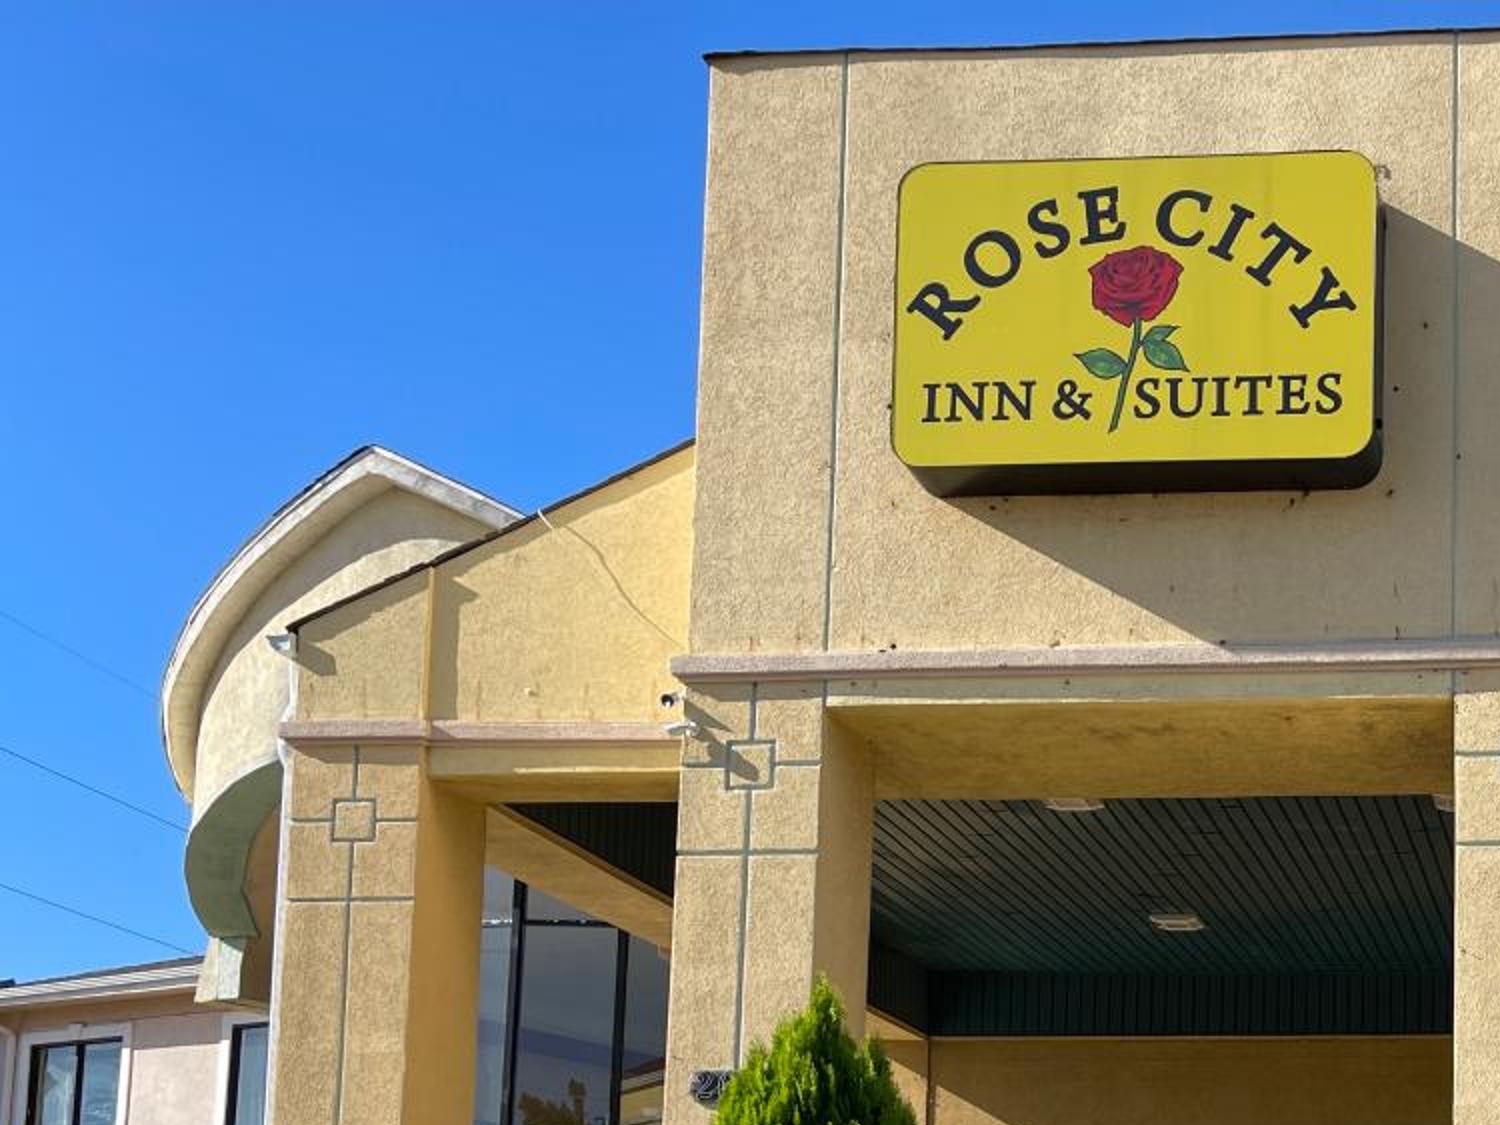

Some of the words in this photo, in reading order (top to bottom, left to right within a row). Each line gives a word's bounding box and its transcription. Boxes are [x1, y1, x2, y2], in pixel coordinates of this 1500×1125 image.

[906, 186, 1127, 340] ROSE
[1155, 188, 1357, 328] CITY
[921, 380, 1036, 423] INN
[1052, 379, 1092, 421] &
[1133, 373, 1343, 419] SUITES
